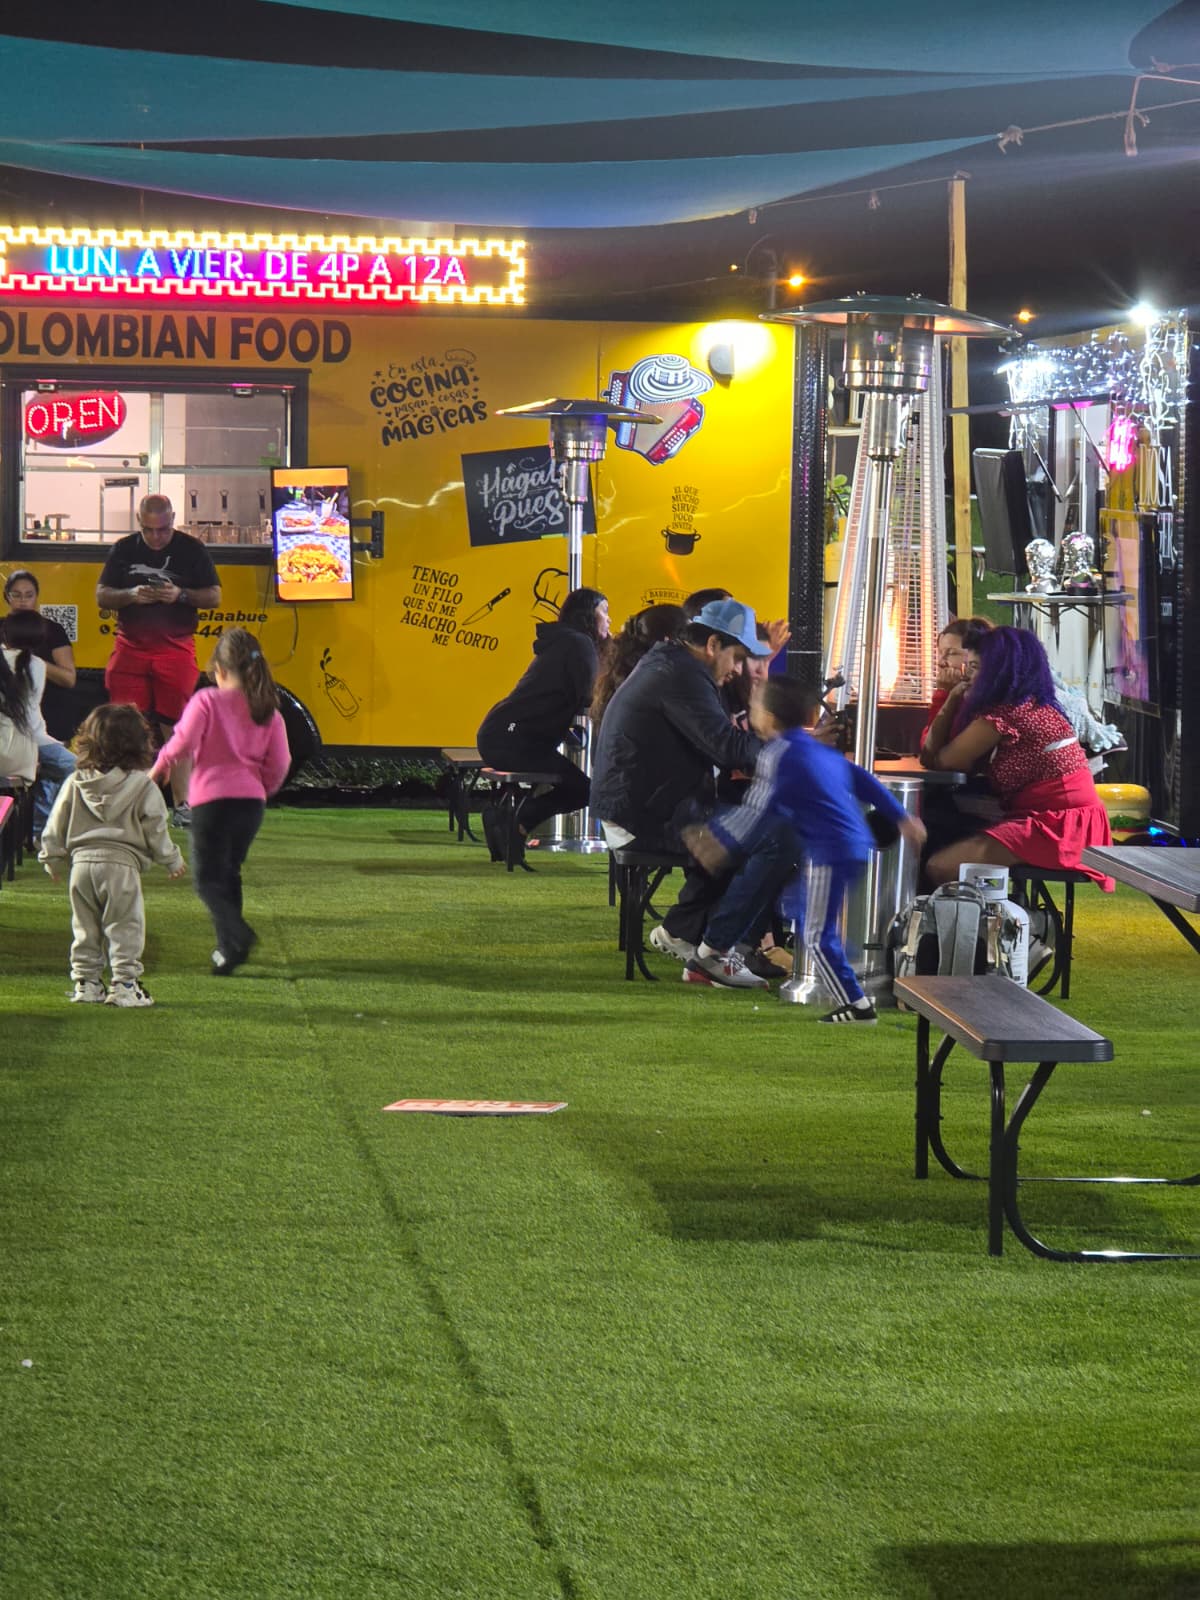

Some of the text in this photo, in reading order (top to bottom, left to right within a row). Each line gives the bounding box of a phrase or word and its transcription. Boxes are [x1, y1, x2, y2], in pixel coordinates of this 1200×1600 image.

[50, 245, 466, 285] LUN. A VIER. DE 4P A 12A
[230, 317, 352, 363] FOOD
[370, 364, 470, 408] COCINA
[28, 395, 119, 435] OPEN
[412, 565, 459, 587] TENGO
[413, 582, 463, 605] UN FILO
[402, 595, 458, 618] QUE SI ME
[400, 610, 457, 635] AGACHO
[432, 633, 450, 646] ME
[455, 629, 499, 652] CORTO
